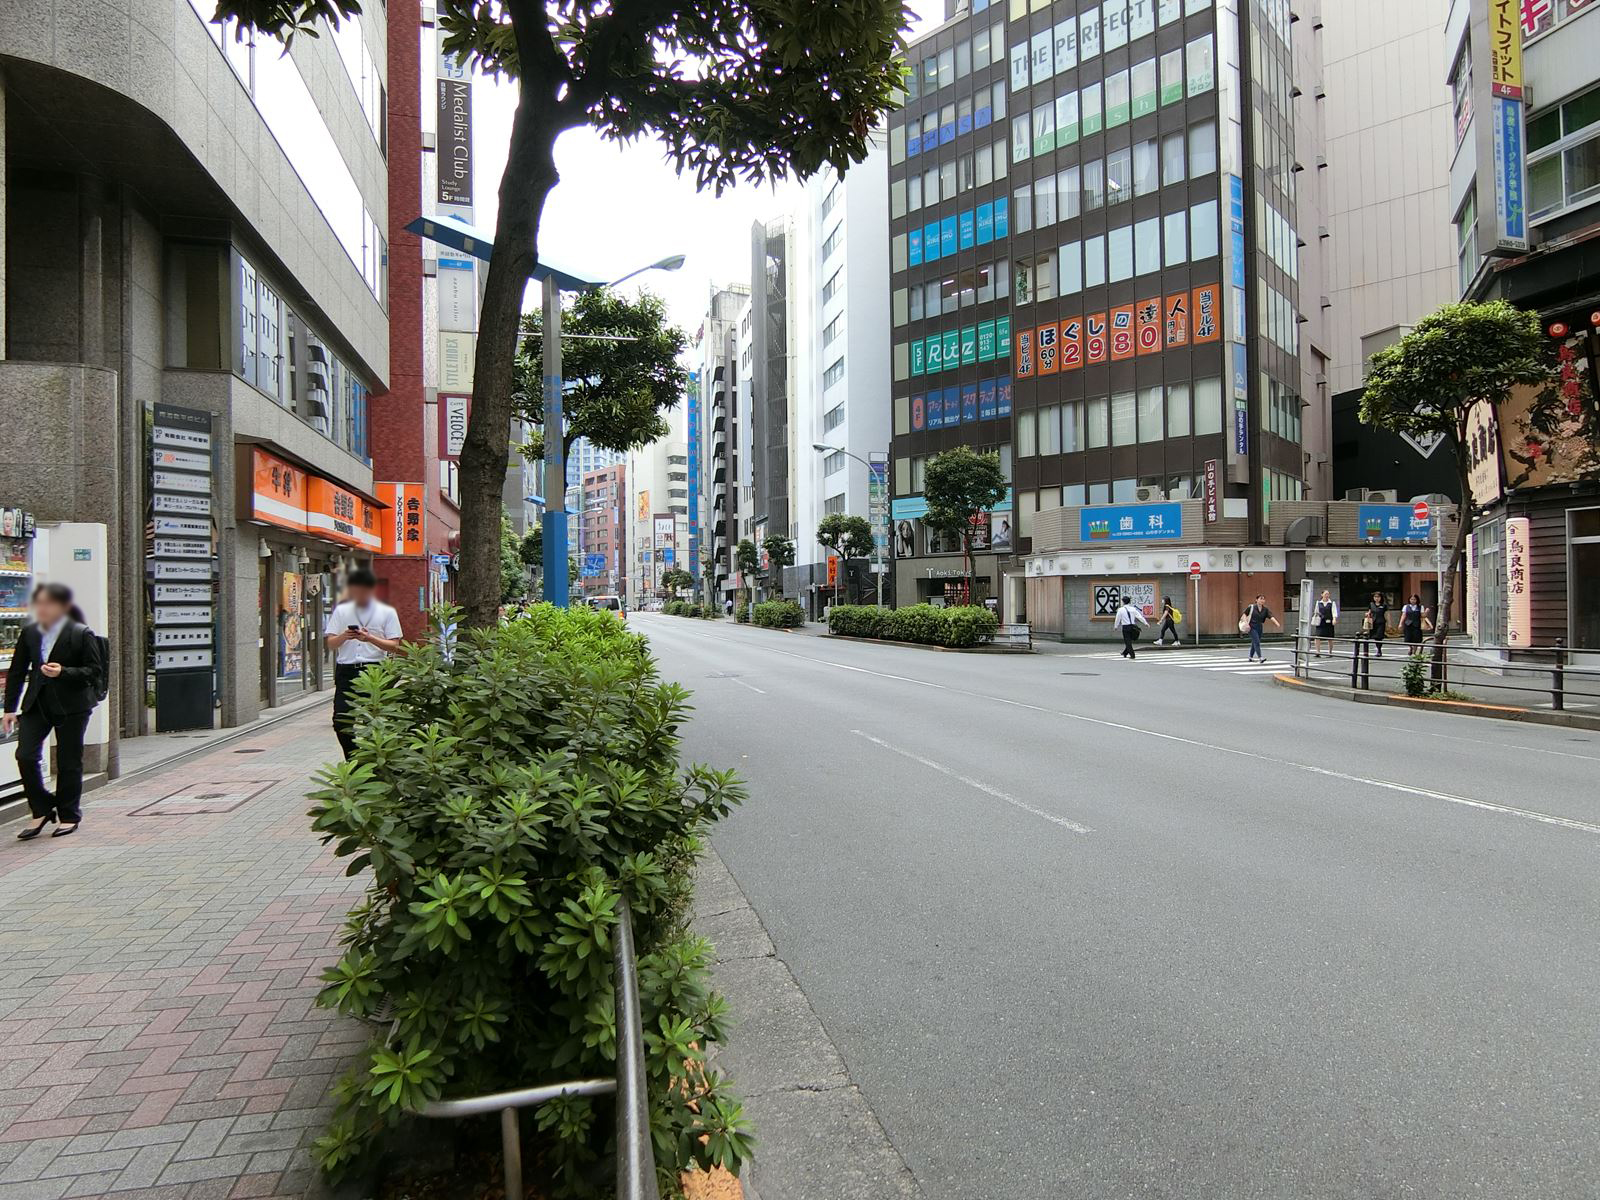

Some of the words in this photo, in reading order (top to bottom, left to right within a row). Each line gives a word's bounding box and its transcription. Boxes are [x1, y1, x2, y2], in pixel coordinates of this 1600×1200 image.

[1013, 45, 1047, 75] THE
[1056, 0, 1146, 57] PERFECT
[1501, 85, 1512, 95] 4F
[453, 83, 467, 142] Medalist
[453, 145, 469, 178] Club
[1198, 289, 1214, 337] 当ビル4F
[446, 338, 459, 359] INDEX
[916, 347, 922, 366] 5F
[1018, 333, 1032, 375] 当ビル4F
[447, 360, 459, 386] STYLE
[450, 408, 464, 441] VELOCE
[271, 466, 292, 498] 牛丼
[1207, 463, 1216, 521] 山の手ビル東館
[333, 491, 354, 521] 吉野家
[407, 498, 420, 542] 吉野家
[1120, 513, 1163, 531] 歯科
[1120, 584, 1153, 594] 東池袋
